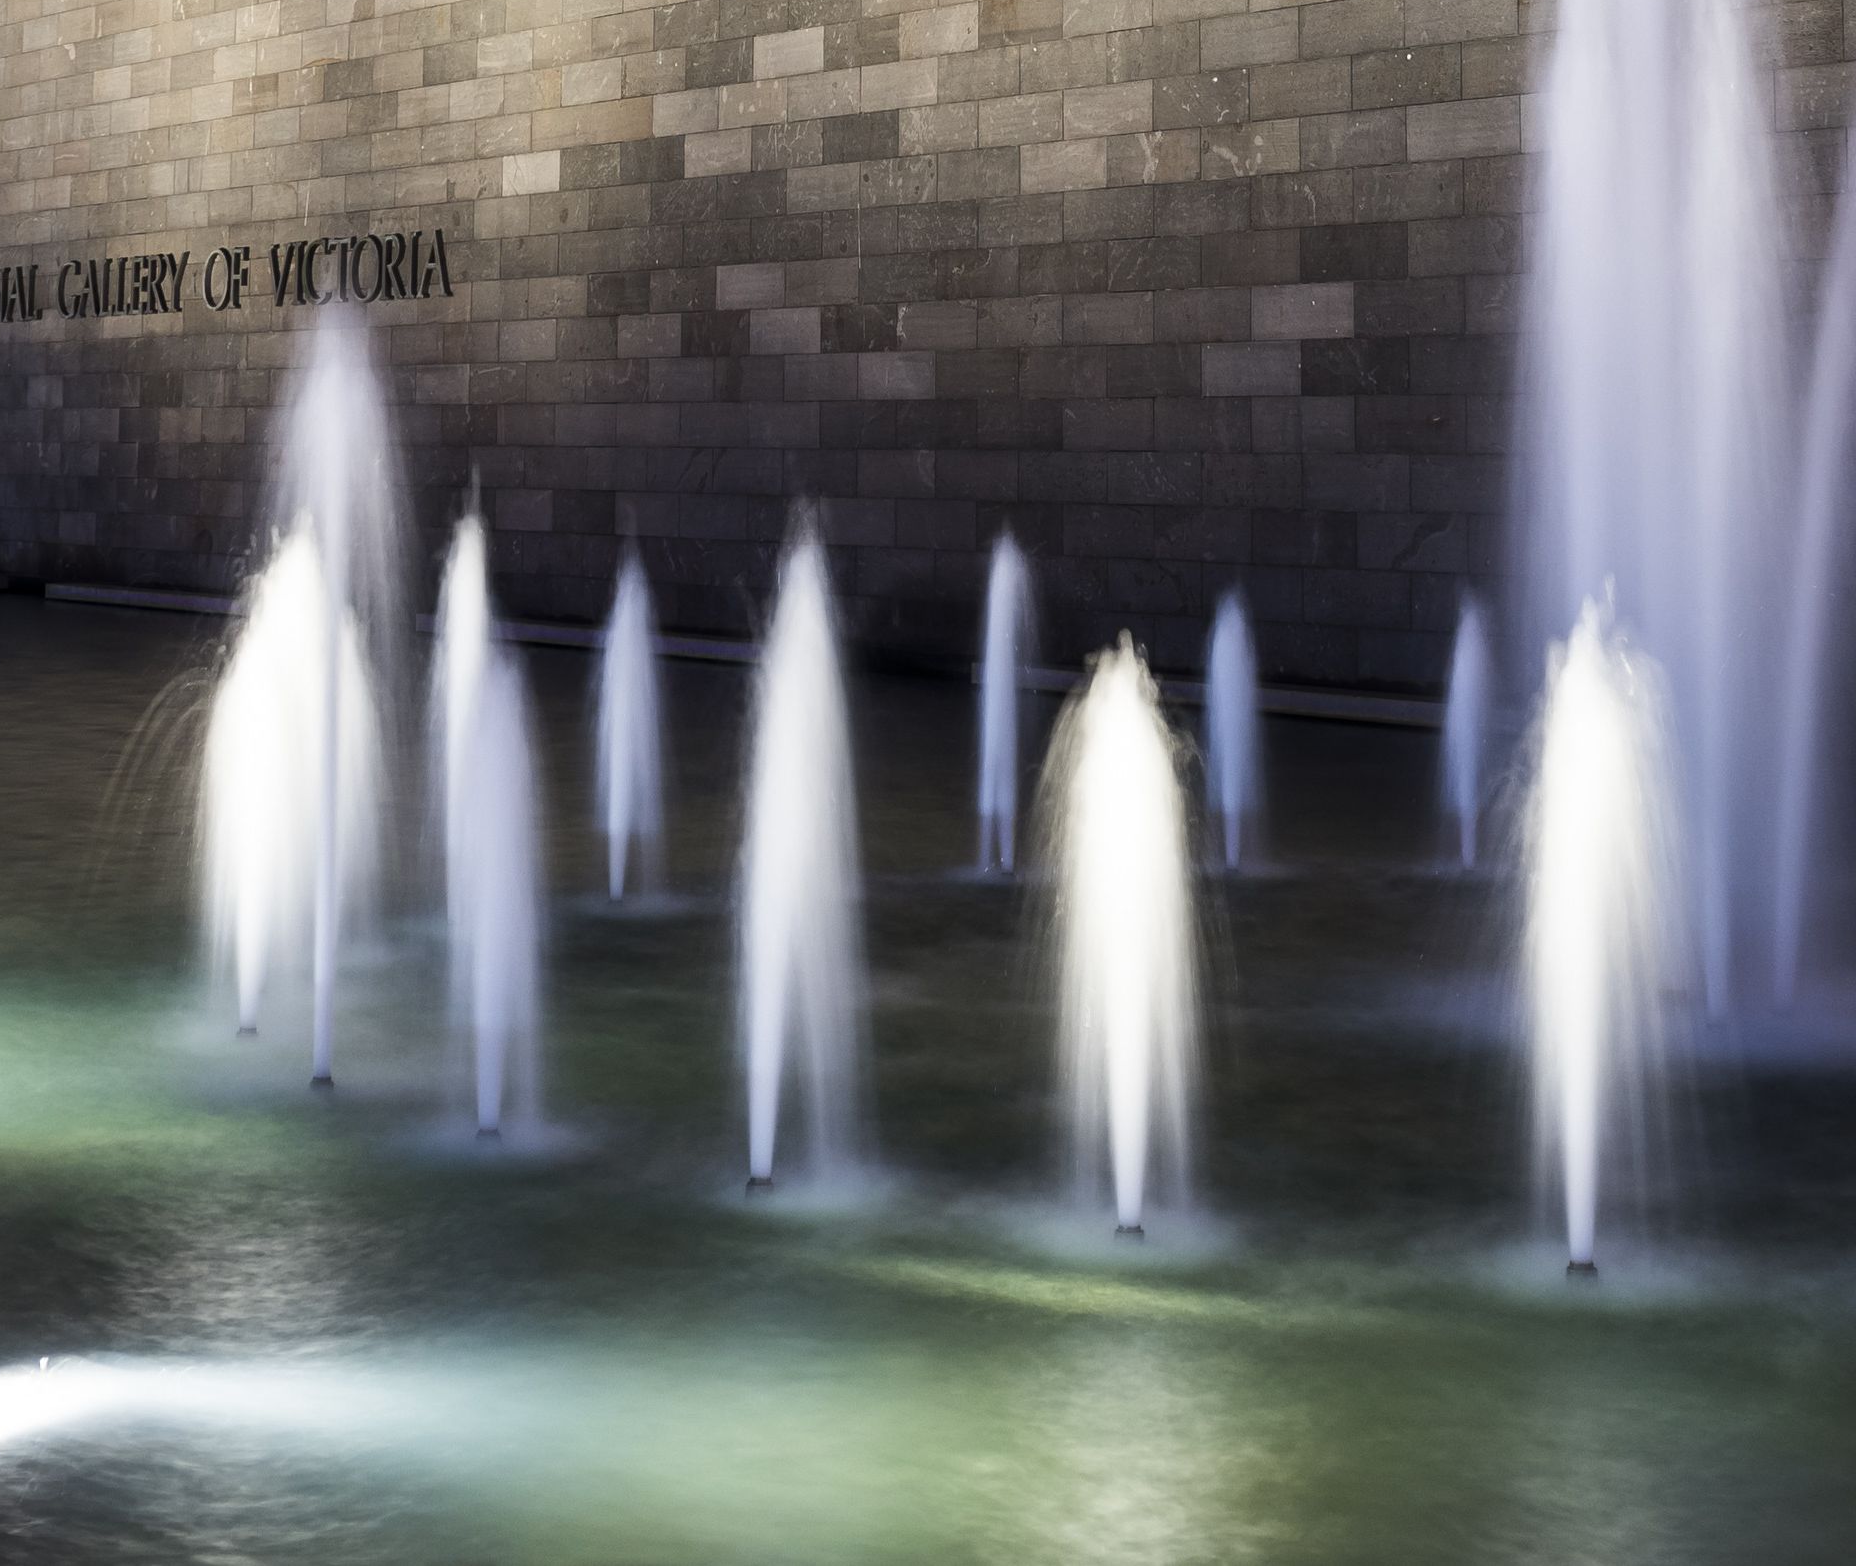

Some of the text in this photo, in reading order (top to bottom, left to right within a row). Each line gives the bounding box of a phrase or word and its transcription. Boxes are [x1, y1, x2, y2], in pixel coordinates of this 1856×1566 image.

[58, 250, 191, 320] GALLERY
[203, 245, 251, 312] OF
[270, 228, 454, 308] VICTORIA
